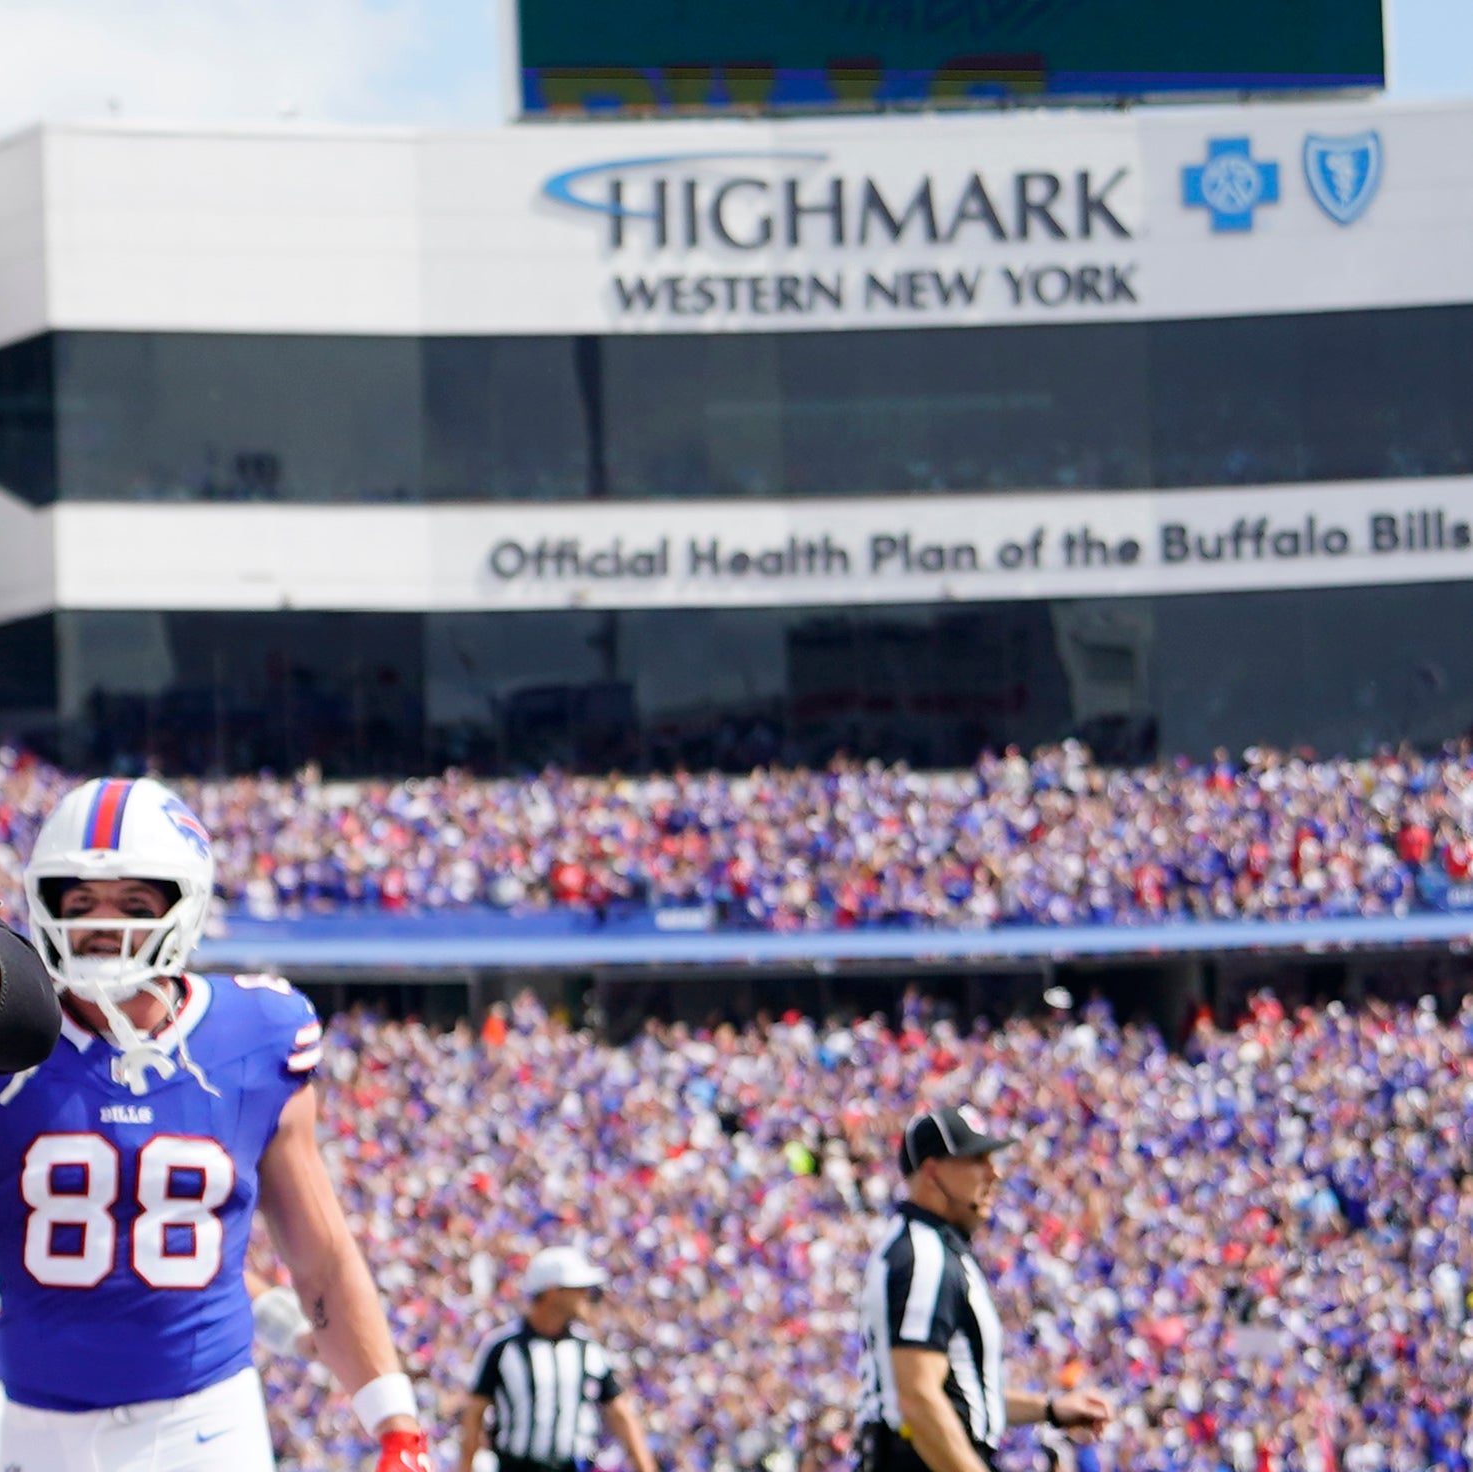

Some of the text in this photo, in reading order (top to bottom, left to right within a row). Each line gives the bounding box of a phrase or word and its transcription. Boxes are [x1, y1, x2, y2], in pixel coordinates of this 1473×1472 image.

[607, 160, 1135, 252] HIGHMARK
[615, 263, 1141, 317] WESTERN NEW YORK
[489, 508, 1472, 580] Official Health Plan of the Buffalo Bills
[99, 1105, 153, 1125] BILLS
[19, 1132, 236, 1291] 88
